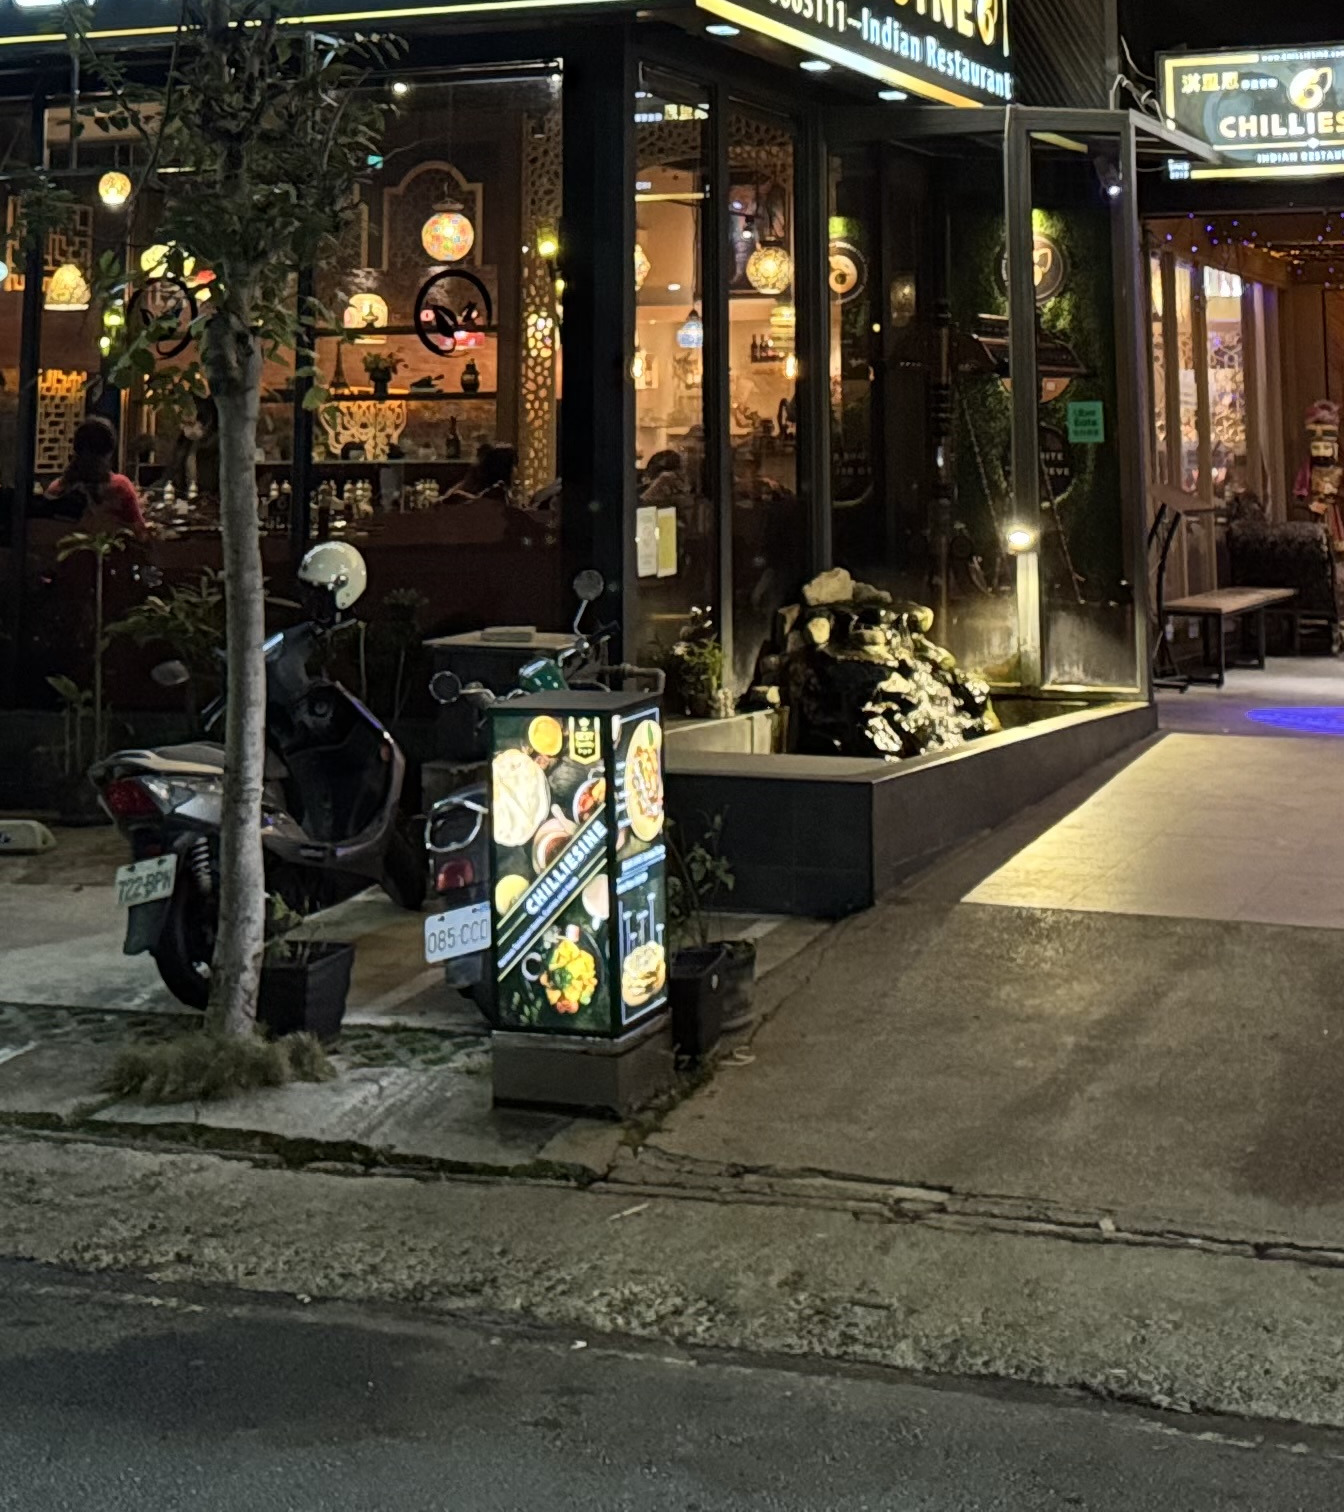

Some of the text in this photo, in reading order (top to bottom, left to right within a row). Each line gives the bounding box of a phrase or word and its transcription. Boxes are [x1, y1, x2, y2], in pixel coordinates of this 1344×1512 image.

[860, 6, 923, 65] Indian
[924, 34, 1015, 102] Restaurant
[525, 819, 608, 915] CHILLIESINE
